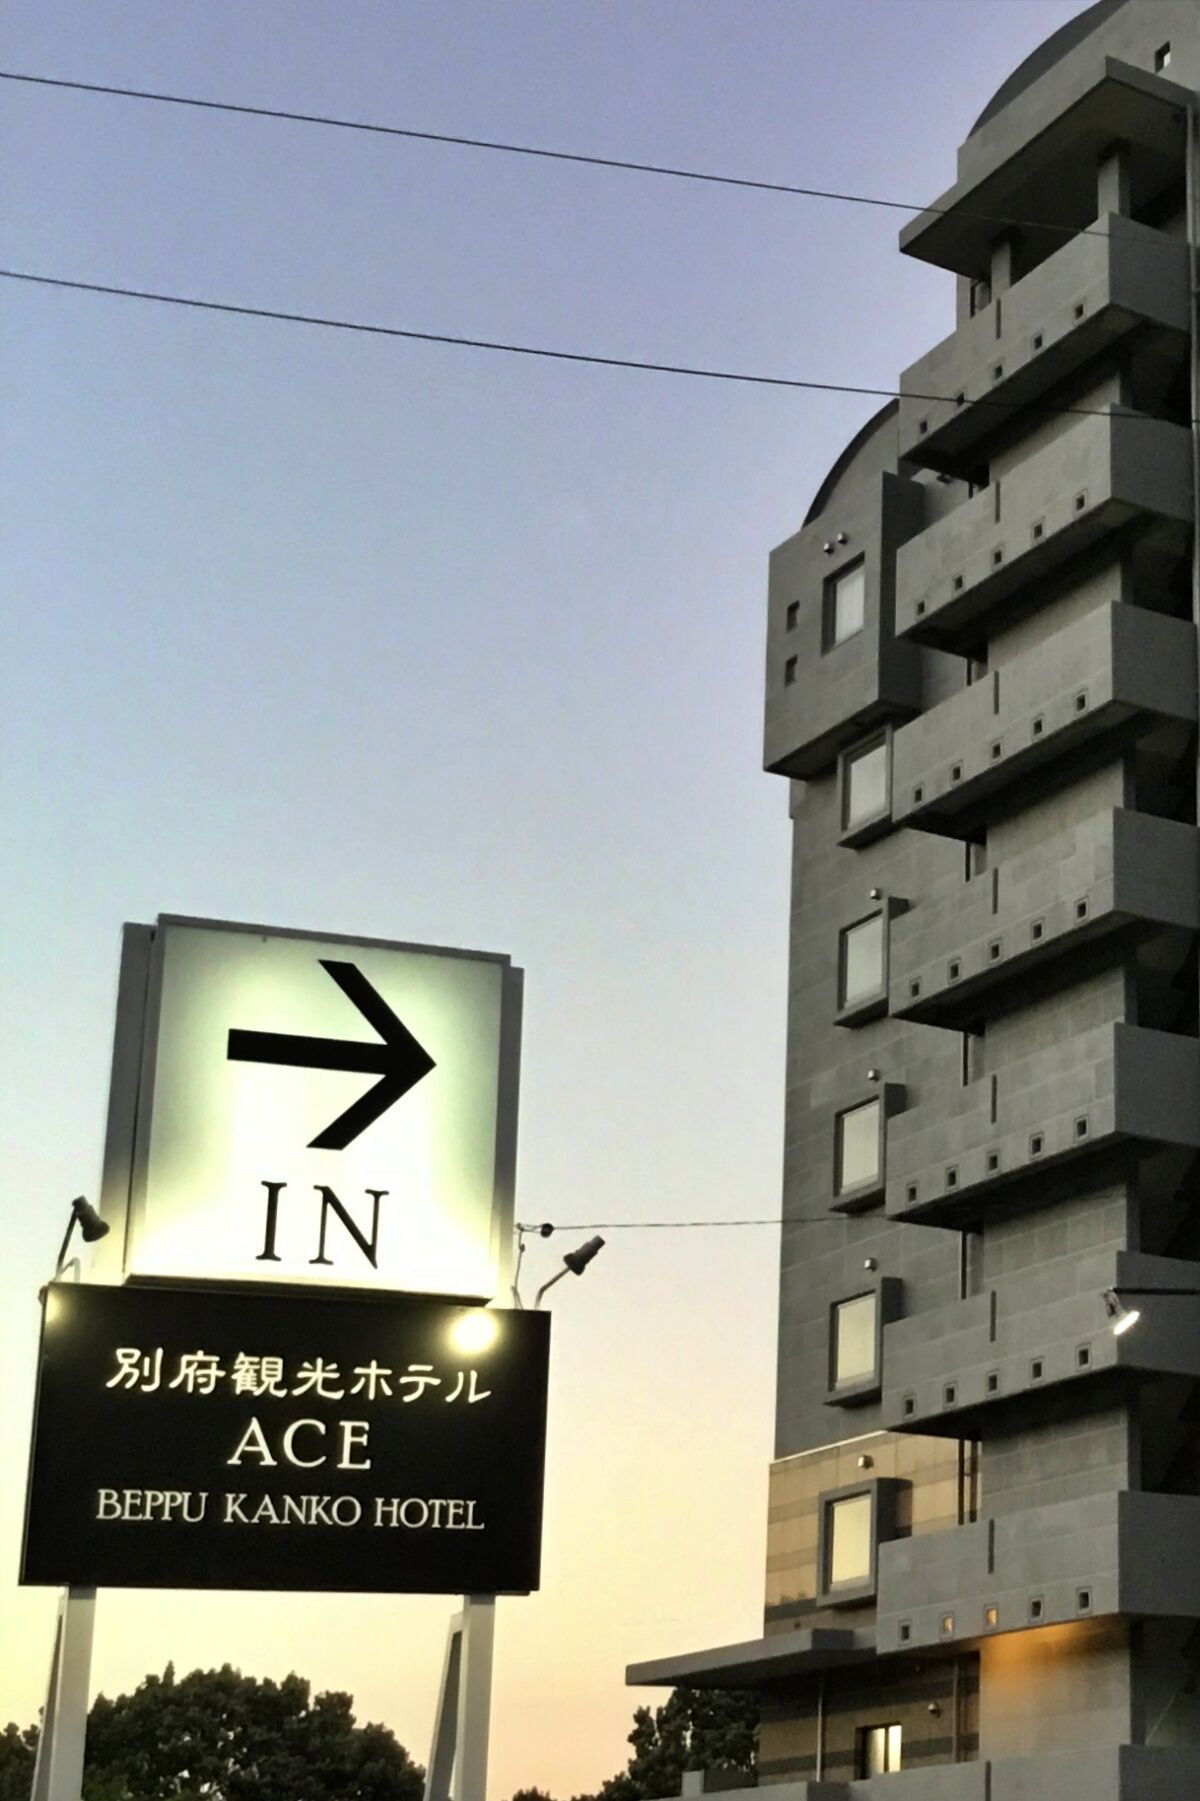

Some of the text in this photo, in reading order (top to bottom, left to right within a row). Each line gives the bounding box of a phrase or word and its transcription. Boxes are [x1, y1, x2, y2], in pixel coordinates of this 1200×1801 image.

[256, 1180, 389, 1270] IN
[106, 1346, 493, 1403] 別府観光ホテル
[227, 1416, 373, 1470] ACE
[96, 1488, 485, 1530] BEPPU KANKO HOTEL
